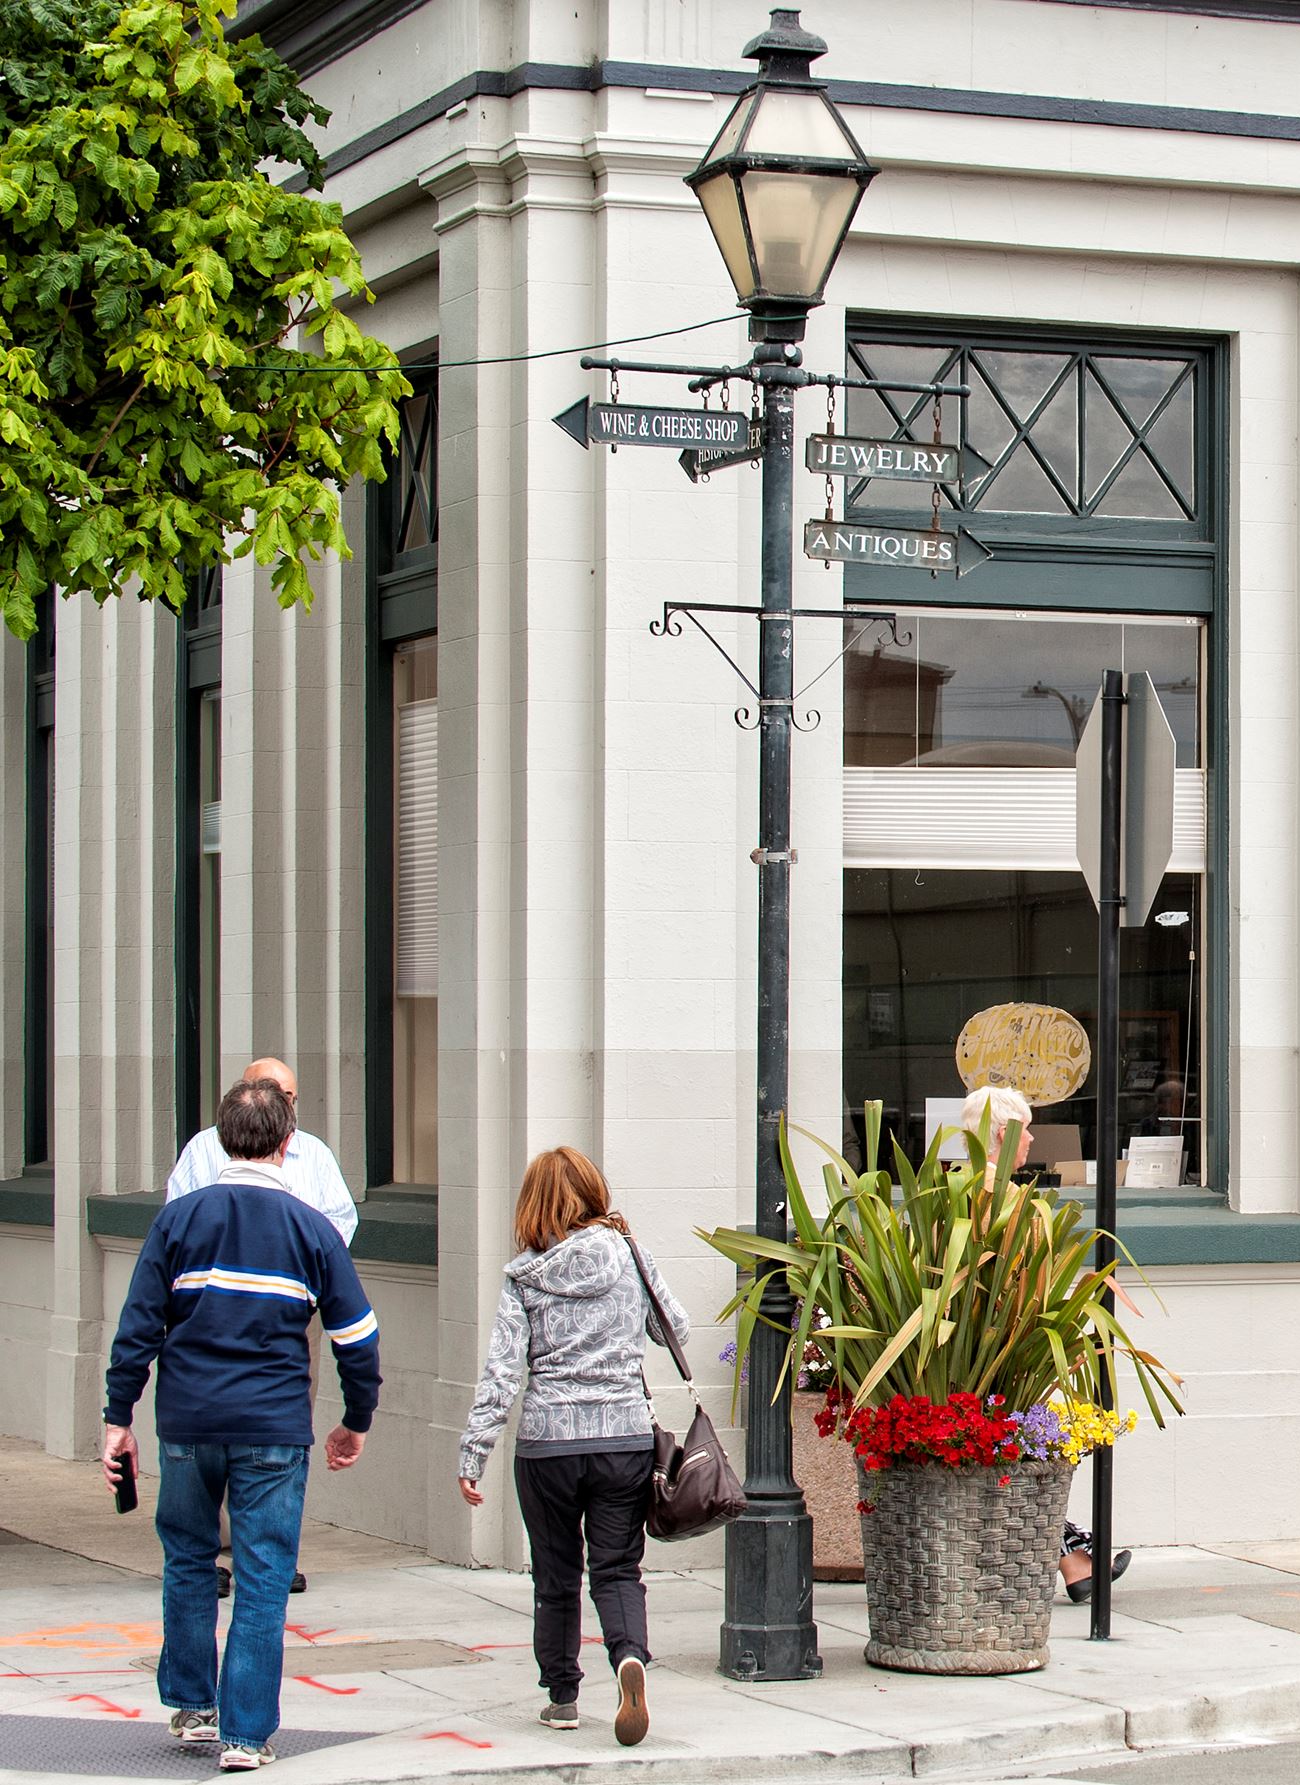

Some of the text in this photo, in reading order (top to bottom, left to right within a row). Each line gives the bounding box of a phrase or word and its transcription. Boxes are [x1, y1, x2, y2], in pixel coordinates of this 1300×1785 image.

[600, 412, 738, 442] WINE & CHEESE SHOP
[817, 443, 950, 474] JEWELRY
[812, 531, 952, 561] ANTIQUES
